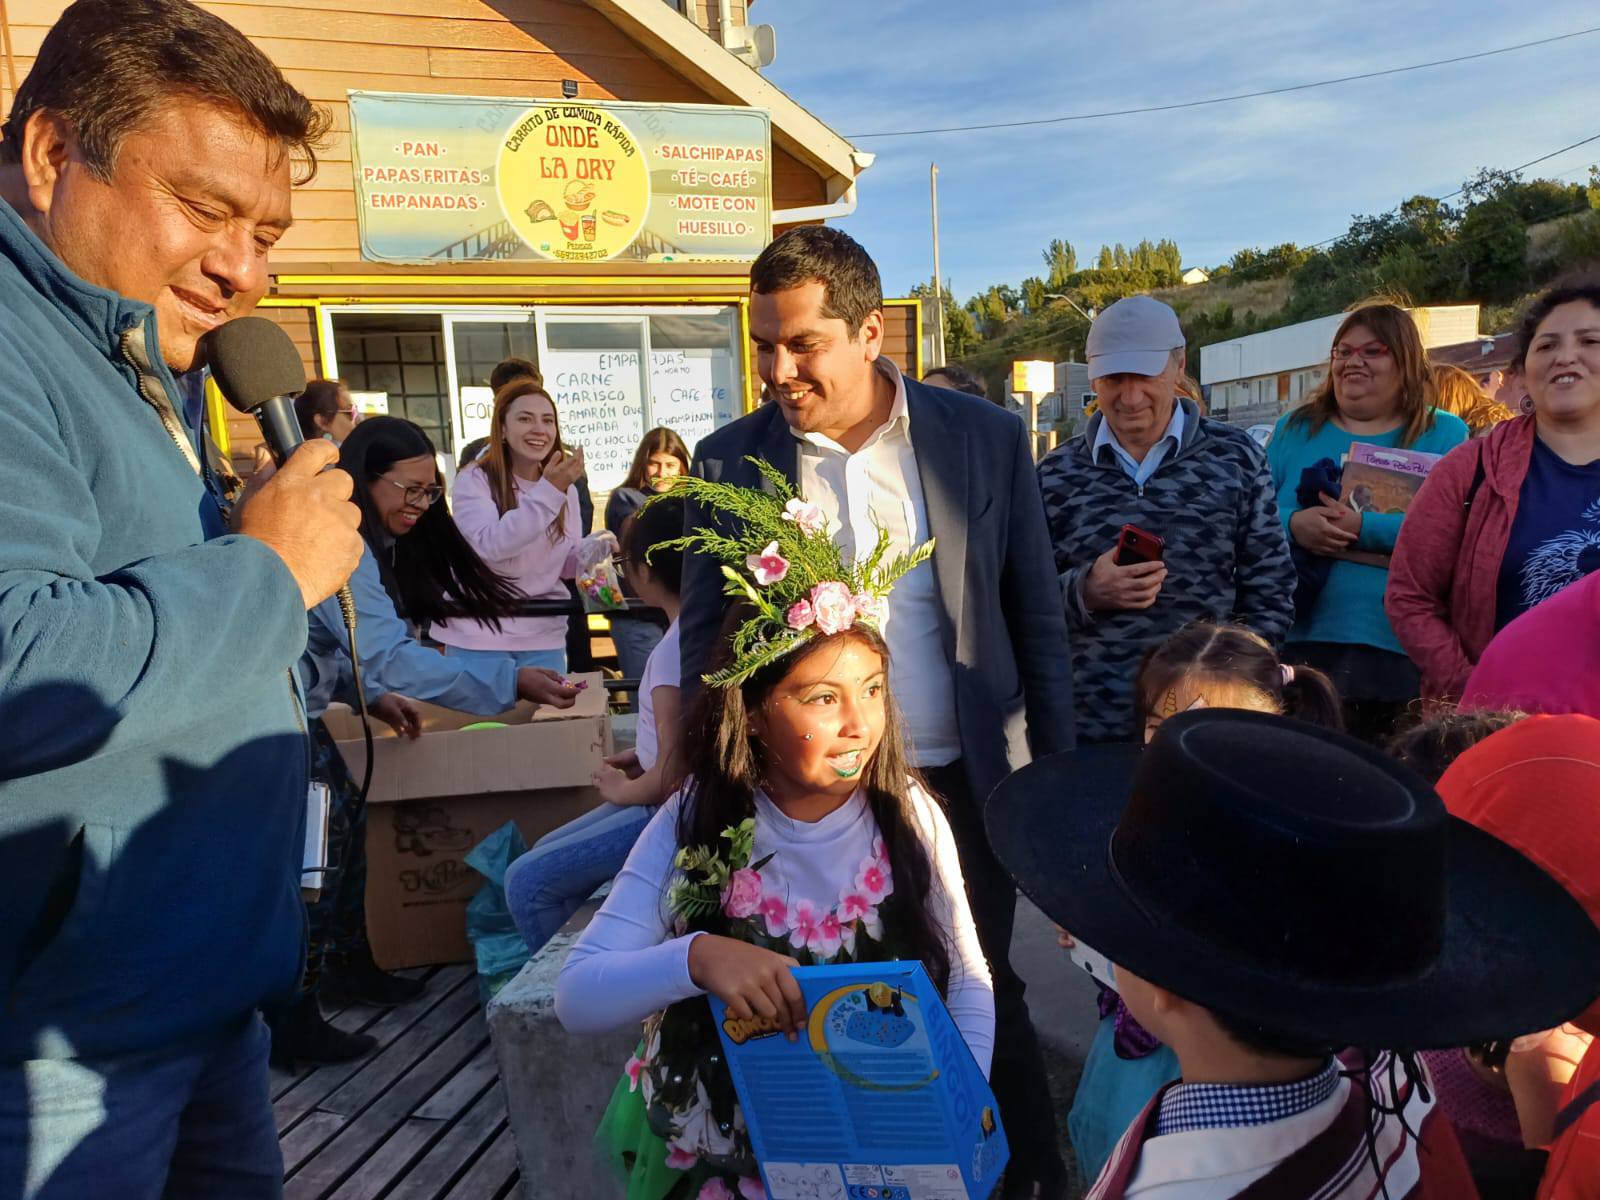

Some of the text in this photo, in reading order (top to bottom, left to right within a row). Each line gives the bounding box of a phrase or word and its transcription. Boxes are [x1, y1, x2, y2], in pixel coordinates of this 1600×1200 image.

[505, 113, 544, 153] CARRITO
[544, 106, 560, 121] DE
[562, 106, 602, 126] COMIDA
[603, 120, 636, 158] RÁPIDA
[545, 124, 600, 149] ONDE
[402, 142, 439, 157] PAN
[661, 145, 764, 162] SALCHIPAPAS
[363, 167, 482, 184] PAPAS FRITAS
[539, 156, 569, 180] LA
[710, 169, 749, 187] CAFÉ
[370, 193, 479, 210] EMPANADAS
[677, 196, 756, 211] MOTE CON
[678, 220, 747, 235] HUESILLO
[556, 372, 614, 388] CARNE
[557, 390, 625, 405] MARISCO
